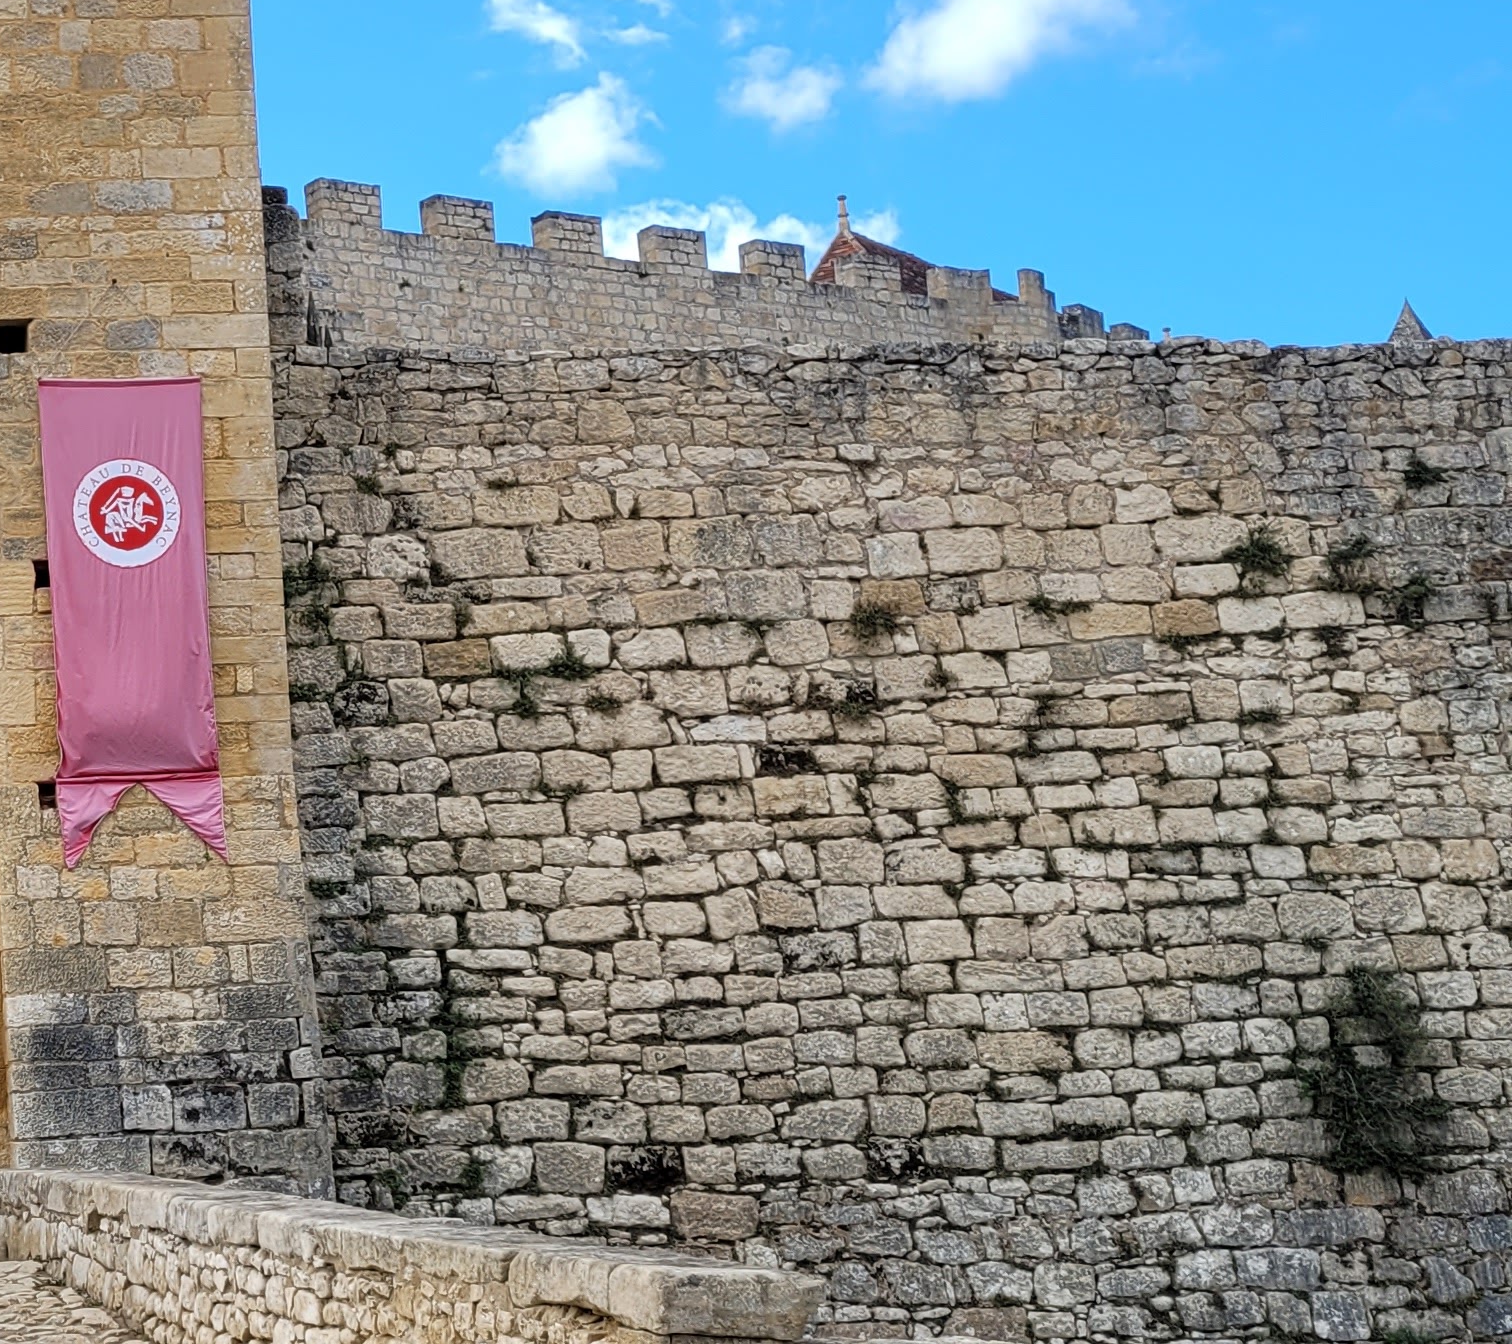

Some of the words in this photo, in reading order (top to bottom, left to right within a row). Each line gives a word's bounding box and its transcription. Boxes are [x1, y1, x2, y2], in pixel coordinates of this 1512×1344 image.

[77, 467, 109, 548] CHATEAU
[121, 463, 145, 477] DE
[152, 475, 178, 548] BEYNAC
